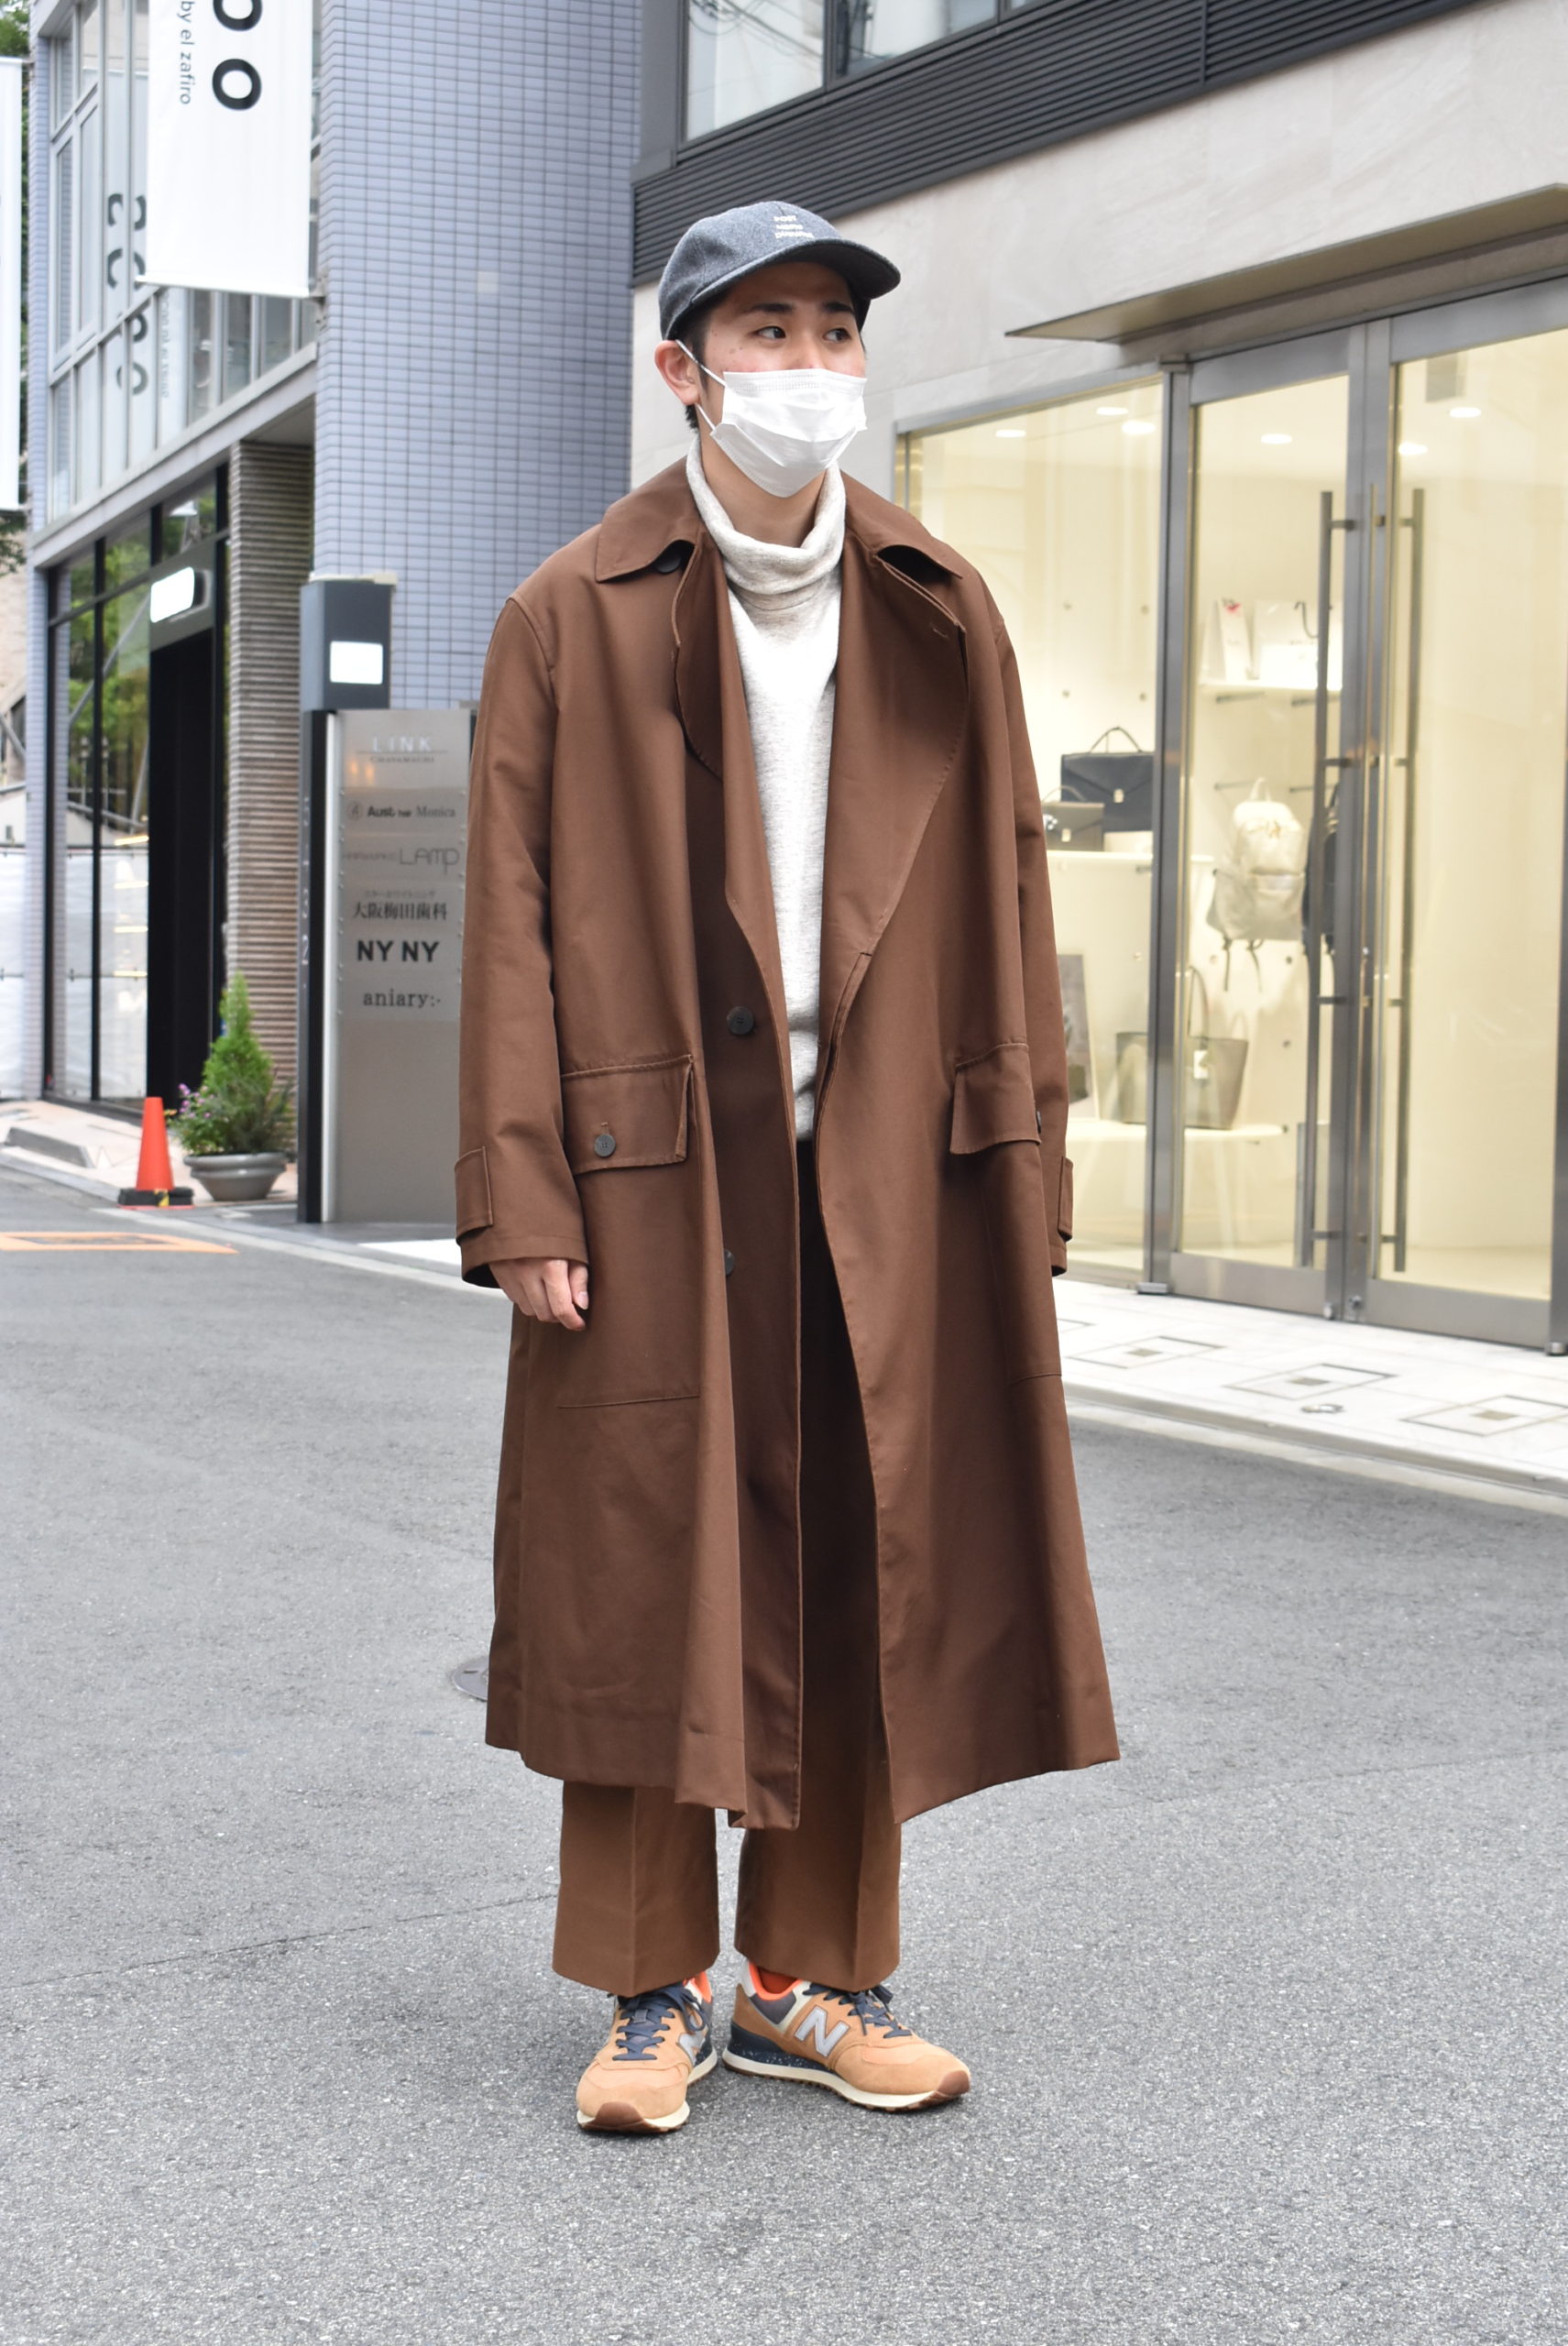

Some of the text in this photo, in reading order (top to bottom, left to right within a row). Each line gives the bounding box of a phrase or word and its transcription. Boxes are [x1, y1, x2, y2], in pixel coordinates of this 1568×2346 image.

[177, 1, 195, 104] by el zafiro
[372, 736, 432, 751] LINK
[417, 805, 456, 817] Monica
[357, 940, 440, 962] NY NY
[794, 2004, 850, 2059] N
